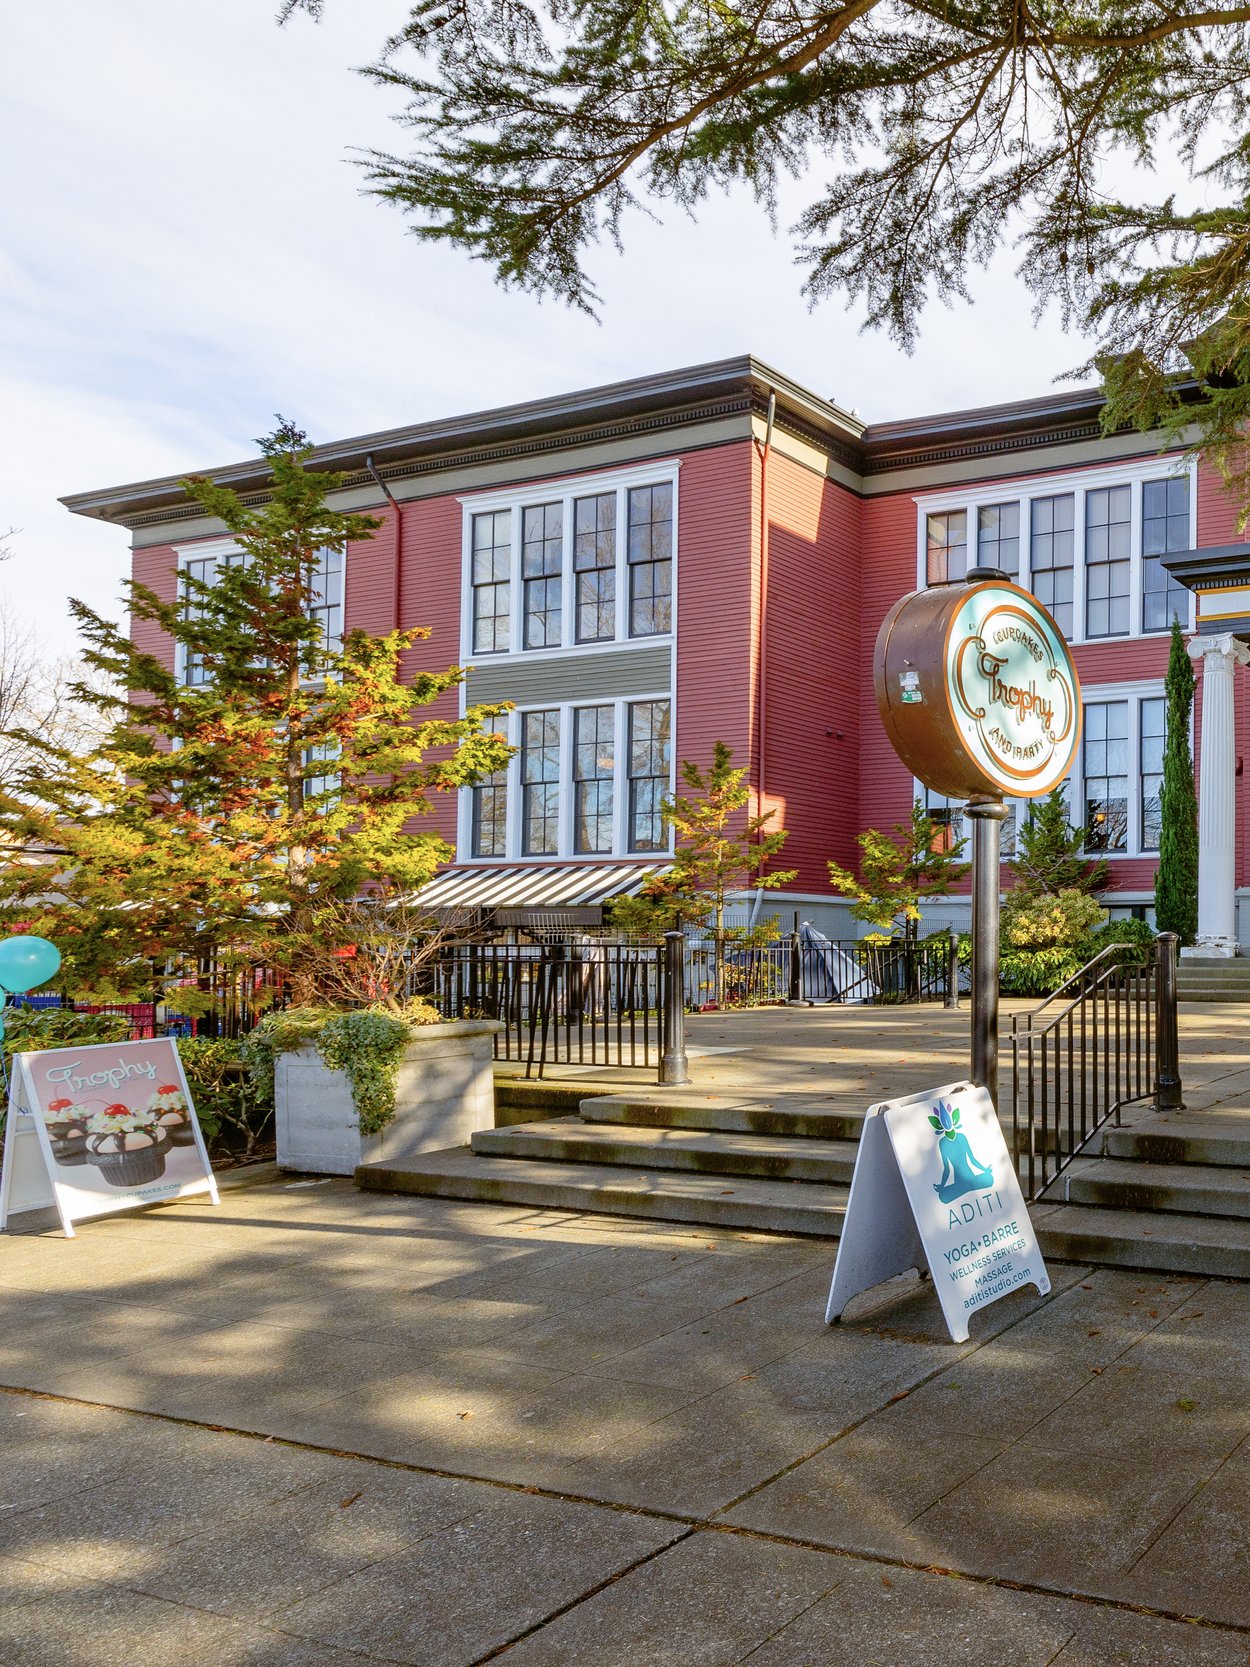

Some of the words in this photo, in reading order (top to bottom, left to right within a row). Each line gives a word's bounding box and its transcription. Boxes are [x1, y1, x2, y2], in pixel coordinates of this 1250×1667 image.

[994, 627, 1044, 662] CUPCAKES
[979, 652, 1054, 730] Trophy
[989, 727, 1012, 754] AND
[1015, 739, 1044, 760] PARTY
[45, 1058, 157, 1093] Trophy
[948, 1191, 1002, 1230] ADITI
[949, 1255, 992, 1282] WELLNESS
[992, 1238, 1026, 1261] SERVICES
[974, 1262, 1013, 1288] MASSAGE
[963, 1268, 1031, 1309] aditistudio.com
